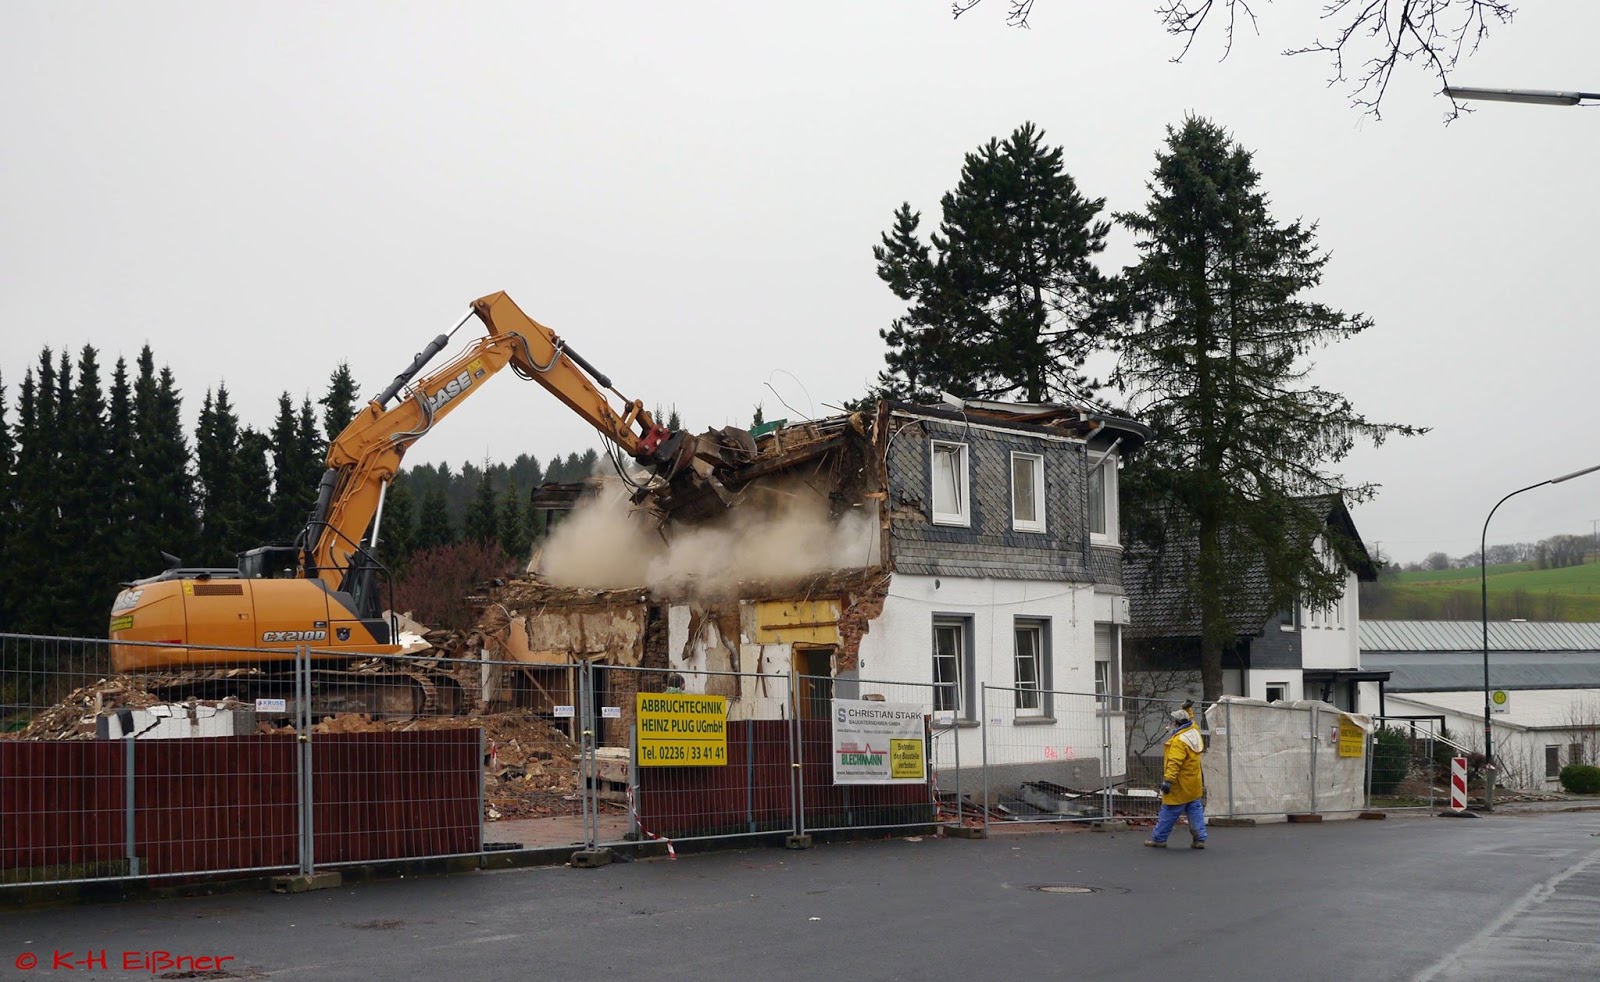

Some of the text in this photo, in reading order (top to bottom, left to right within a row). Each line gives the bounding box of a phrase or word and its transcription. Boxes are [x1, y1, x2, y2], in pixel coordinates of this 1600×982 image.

[262, 629, 326, 642] CX210D
[641, 699, 722, 714] ABBRUCHTECHNIK
[848, 709, 893, 719] CHRISTIAN
[895, 711, 921, 720] STARK
[641, 719, 723, 733] HEINZ PLUG UGmbH
[642, 746, 657, 759] Tel.
[659, 746, 685, 759] 02236
[691, 747, 701, 759] 33
[703, 747, 713, 759] 41
[715, 747, 724, 759] 41
[841, 754, 883, 766] BLECHMANN
